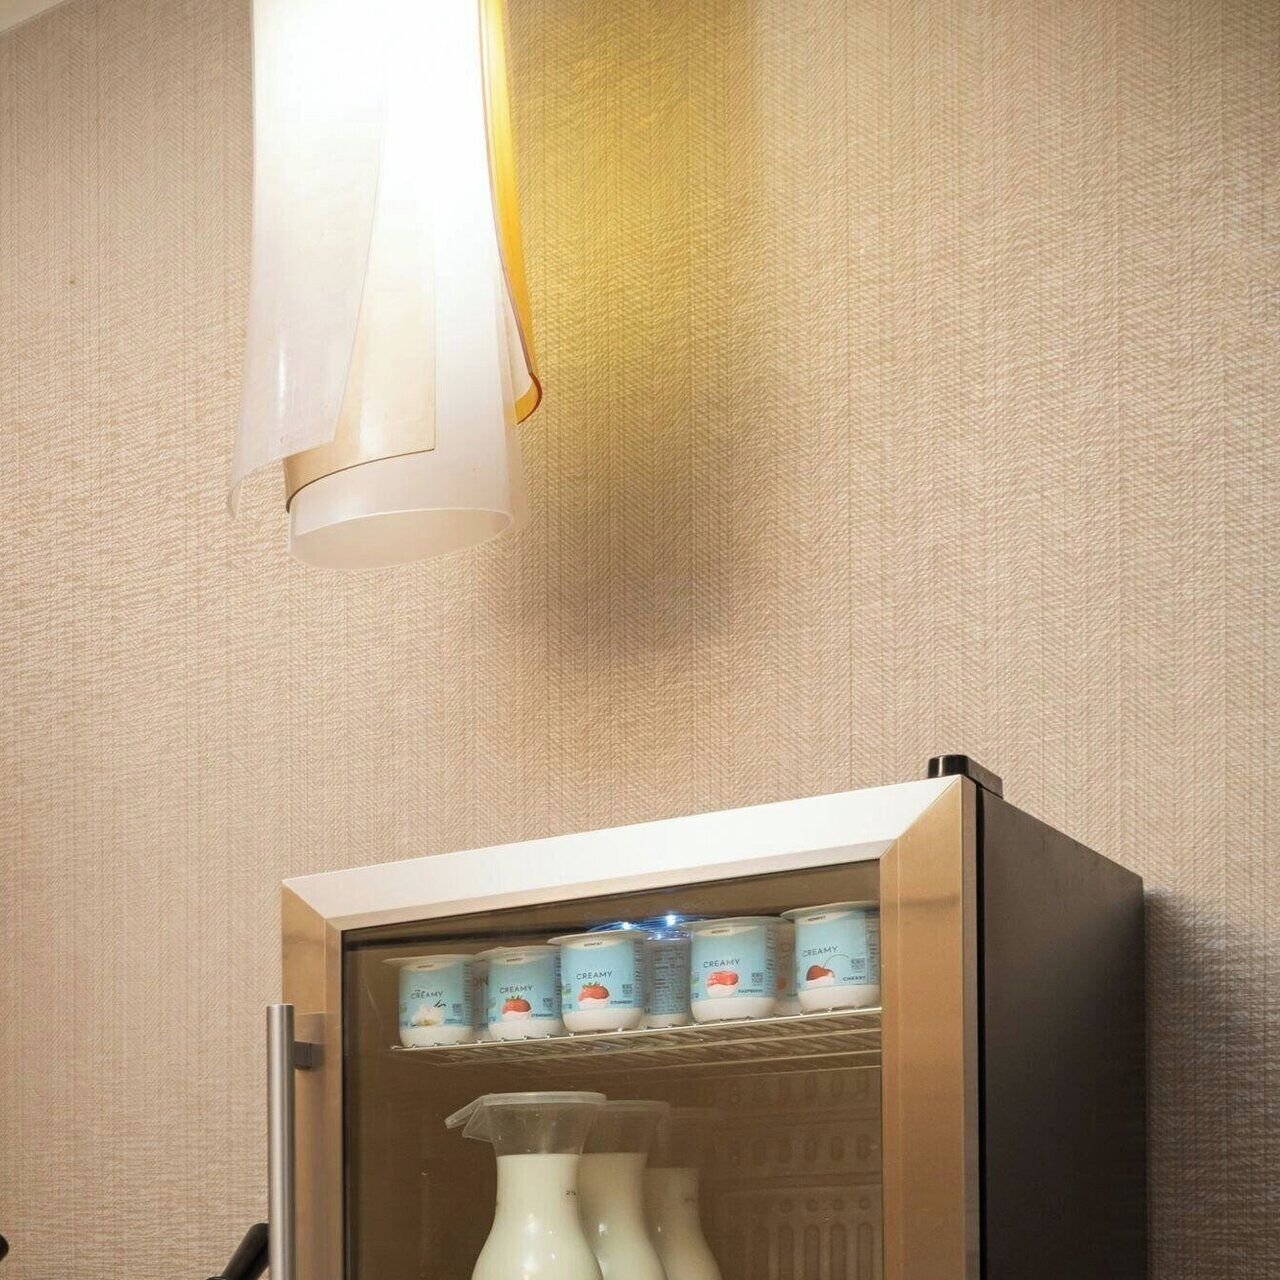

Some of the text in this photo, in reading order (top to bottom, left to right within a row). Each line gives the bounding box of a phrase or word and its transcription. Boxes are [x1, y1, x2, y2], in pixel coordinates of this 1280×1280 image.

[802, 946, 838, 957] CREAMY
[703, 959, 740, 968] CREAMY
[576, 971, 612, 980] CREAMY
[499, 984, 533, 994] CREAMY
[411, 991, 443, 1000] CREAMY
